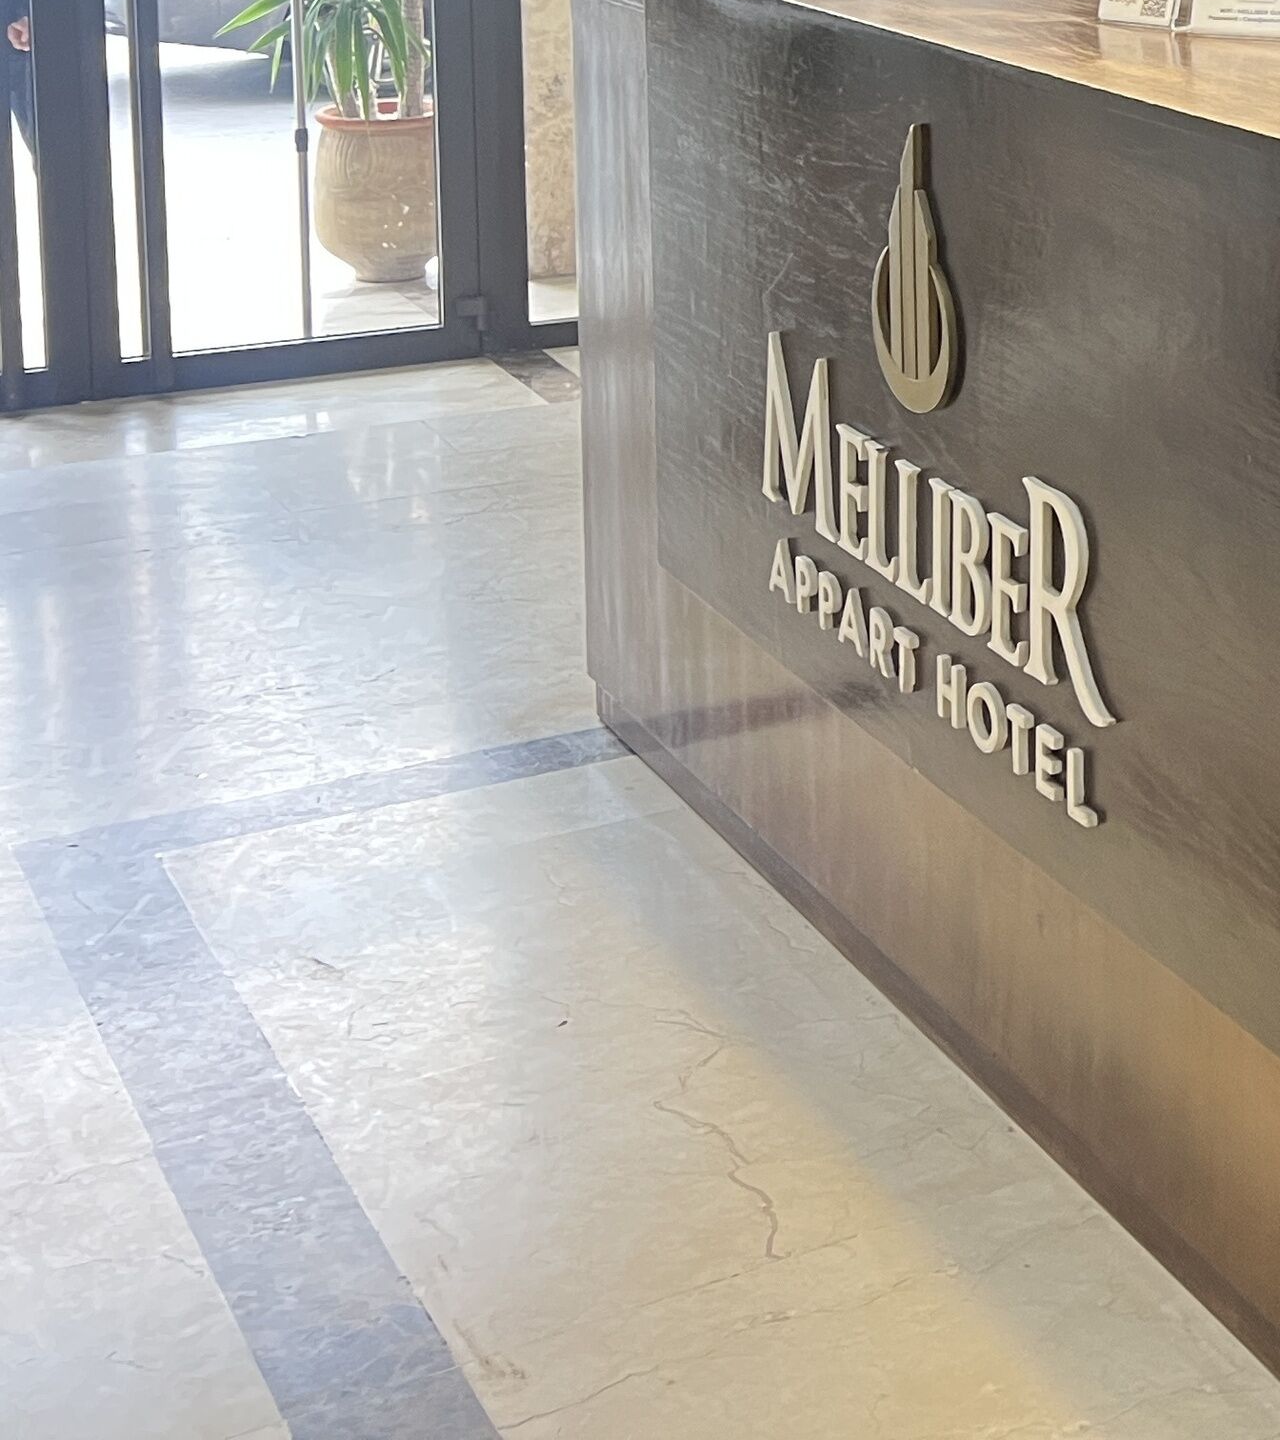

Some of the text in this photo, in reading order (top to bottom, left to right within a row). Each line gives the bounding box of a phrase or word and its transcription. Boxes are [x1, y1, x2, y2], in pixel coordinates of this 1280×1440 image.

[761, 330, 1117, 728] MELLIBER
[768, 537, 1098, 829] APPART HOTEL
